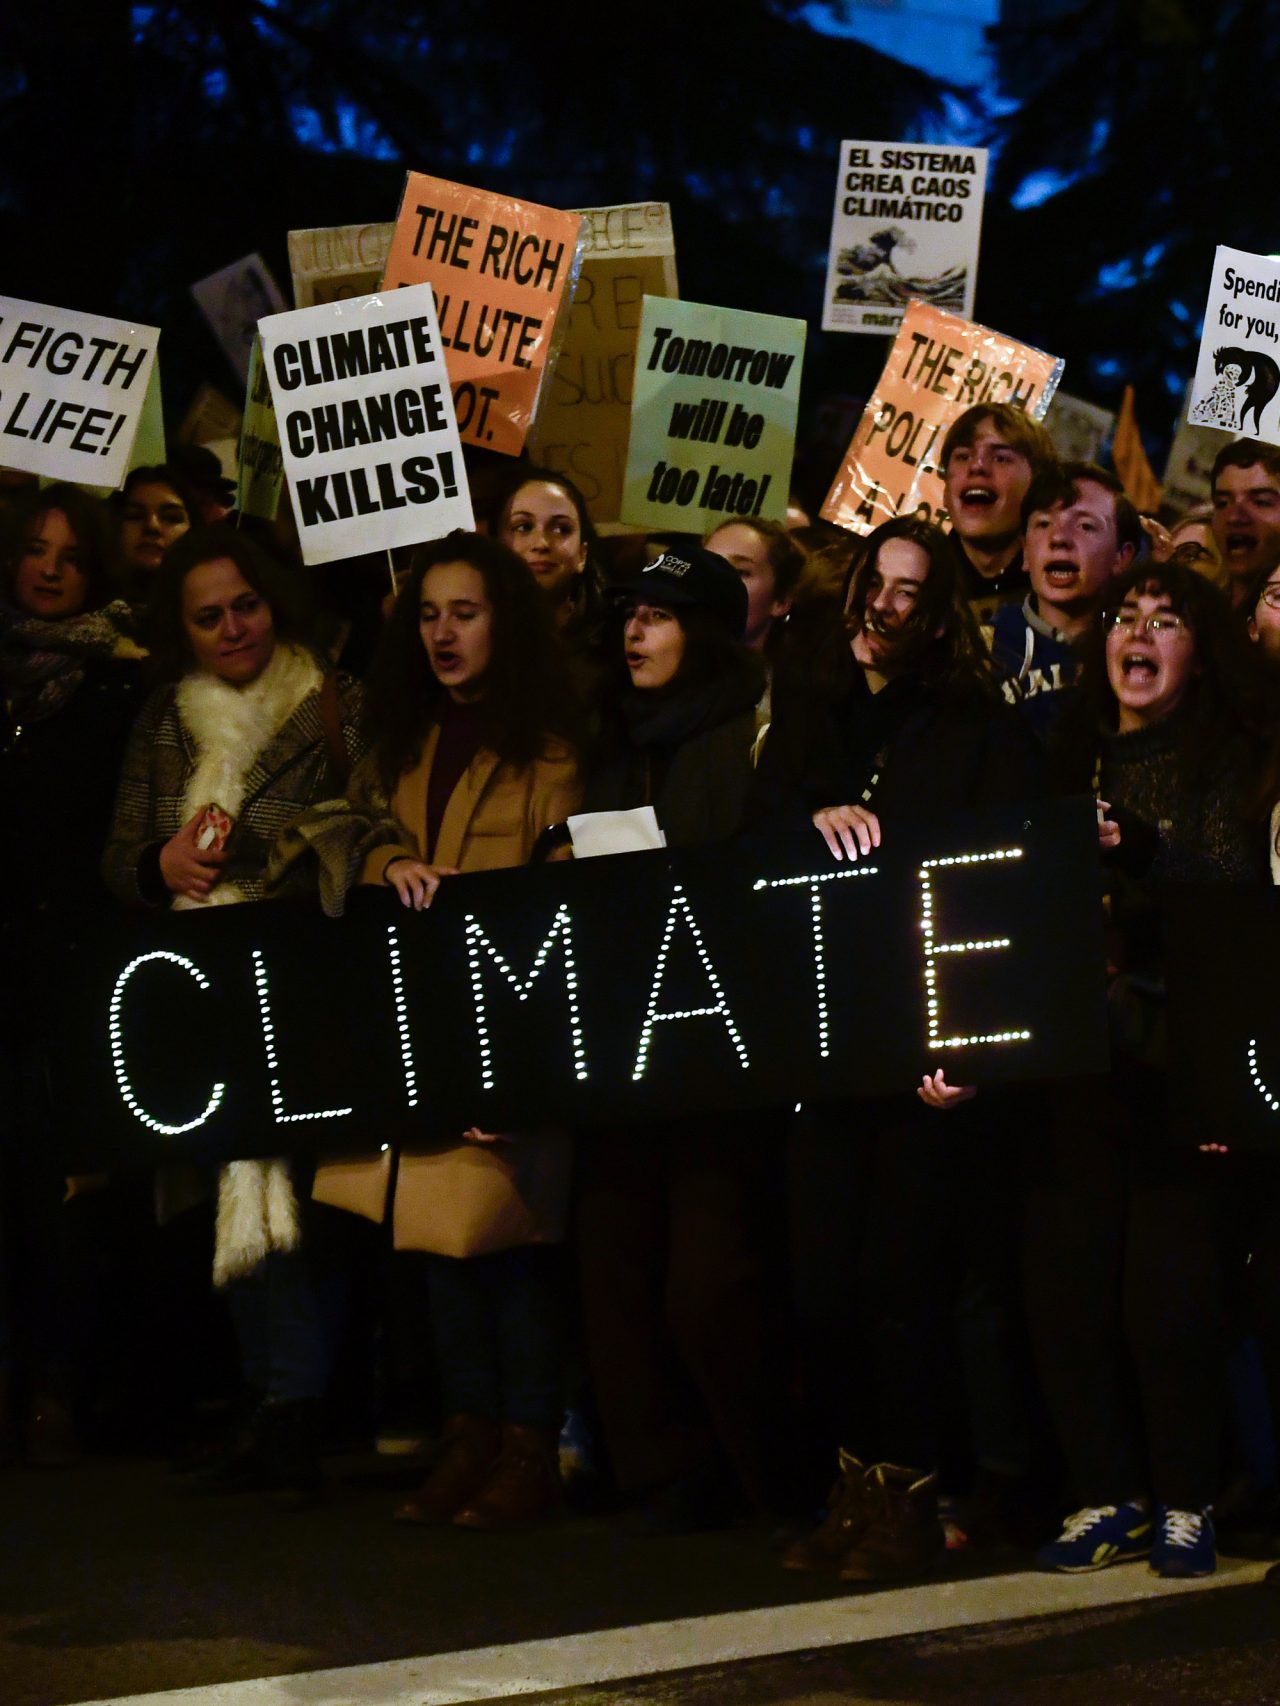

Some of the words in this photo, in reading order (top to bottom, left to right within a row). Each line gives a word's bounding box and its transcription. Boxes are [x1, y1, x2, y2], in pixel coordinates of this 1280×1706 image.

[845, 172, 904, 194] CREA
[911, 176, 970, 199] CAOS
[848, 149, 873, 168] EL
[880, 149, 976, 175] SISTEMA
[842, 196, 963, 223] CLIMÁTICO
[412, 205, 479, 269] THE
[479, 224, 565, 292] RICH
[2, 322, 148, 390] FIGTH
[273, 317, 436, 391] CLIMATE
[398, 282, 542, 370] LLUTE
[1218, 303, 1243, 329] for
[1247, 316, 1279, 343] you,
[647, 327, 795, 390] Tomorrow
[901, 332, 964, 394] THE
[954, 358, 1036, 409] RICH
[3, 392, 127, 456] LIFE!
[286, 384, 448, 459] CHANGE
[667, 399, 728, 444] will
[723, 403, 765, 450] be
[296, 451, 459, 527] KILLS!
[647, 461, 700, 507] too
[698, 465, 772, 517] late!
[109, 849, 1031, 1134] CLIMATE
